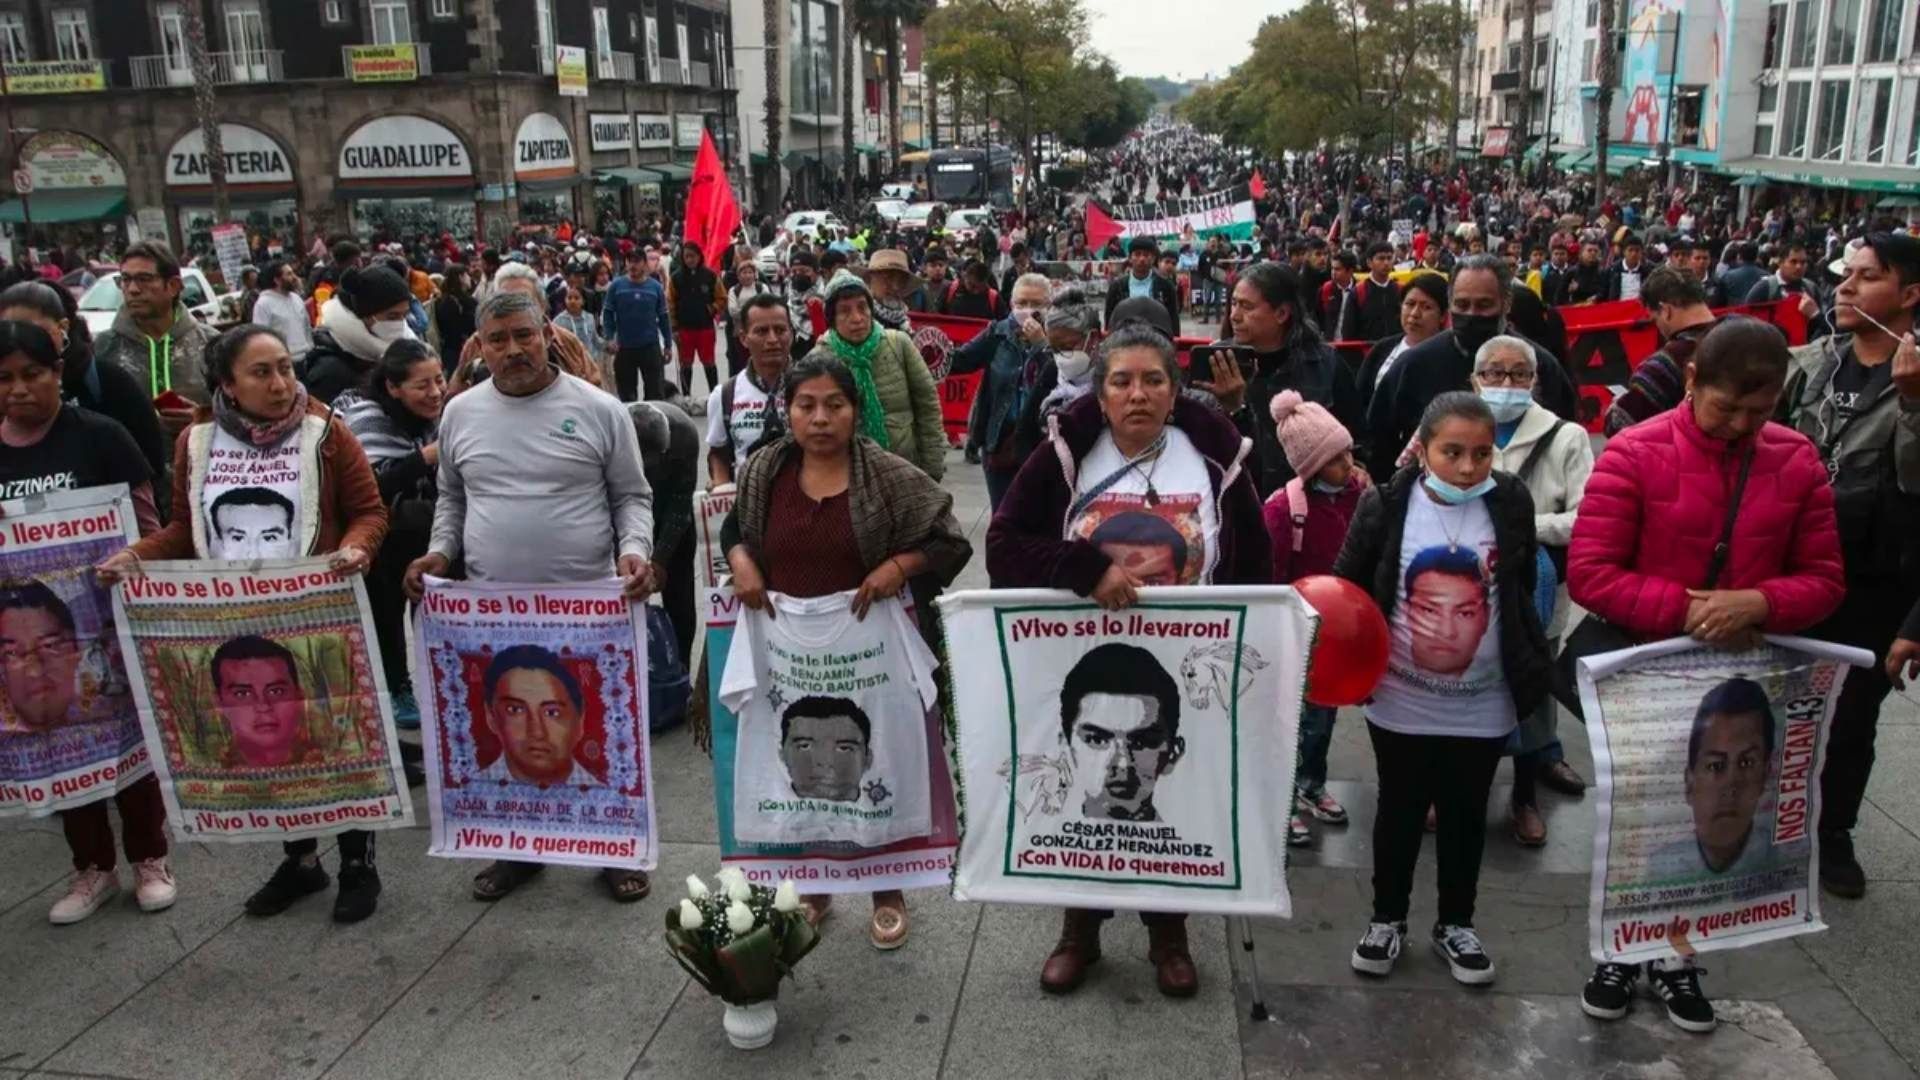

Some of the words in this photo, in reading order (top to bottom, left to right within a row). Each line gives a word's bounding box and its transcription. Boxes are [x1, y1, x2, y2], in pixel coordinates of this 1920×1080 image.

[172, 150, 286, 176] ZAPTERIA
[344, 143, 462, 169] GUADALUPE
[518, 138, 571, 162] ZAPATERIA
[228, 449, 242, 460] se
[246, 448, 259, 460] lo
[11, 508, 118, 546] llevaron!
[123, 574, 177, 602] ¡Vivo
[184, 581, 208, 598] se
[212, 576, 234, 598] lo
[423, 591, 470, 617] ¡Vivo
[476, 597, 503, 614] se
[507, 595, 529, 615] lo
[534, 594, 628, 616] llevaron!
[1012, 617, 1068, 642] ¡Vivo
[1074, 620, 1096, 636] se
[1102, 614, 1123, 636] lo
[1128, 614, 1231, 639] llevaron!
[805, 653, 820, 667] lo
[767, 667, 823, 693] ASCENCIO
[826, 671, 890, 693] BAUTISTA
[790, 665, 856, 682] BENJAMÍN
[1786, 697, 1823, 721] 43
[1780, 719, 1816, 795] FALTAN
[24, 784, 45, 802] lo
[51, 746, 149, 797] queremos
[195, 811, 244, 832] ¡Vivo
[249, 811, 269, 829] lo
[275, 800, 389, 832] queremos!
[556, 803, 573, 816] DE
[581, 805, 598, 817] LA
[603, 806, 636, 820] CRUZ
[787, 800, 815, 813] VIDA
[817, 800, 829, 813] lo
[1776, 796, 1807, 841] NOS
[455, 827, 504, 850] ¡Vivo
[509, 831, 527, 850] lo
[532, 835, 637, 858] queremos!
[1061, 820, 1114, 838] CÉSAR
[1116, 825, 1183, 841] MANUEL
[1030, 834, 1114, 851] GONZÁLEZ
[1117, 837, 1214, 858] HERNÁNDEZ
[777, 866, 819, 881] vida
[824, 863, 841, 879] lo
[847, 853, 954, 881] queremos!
[1016, 850, 1057, 869] ¡Con
[1060, 852, 1104, 871] VIDA
[1107, 853, 1126, 872] lo
[1129, 858, 1225, 877] queremos!
[1612, 920, 1665, 953] ¡Vivo
[1695, 893, 1797, 937] queremos!
